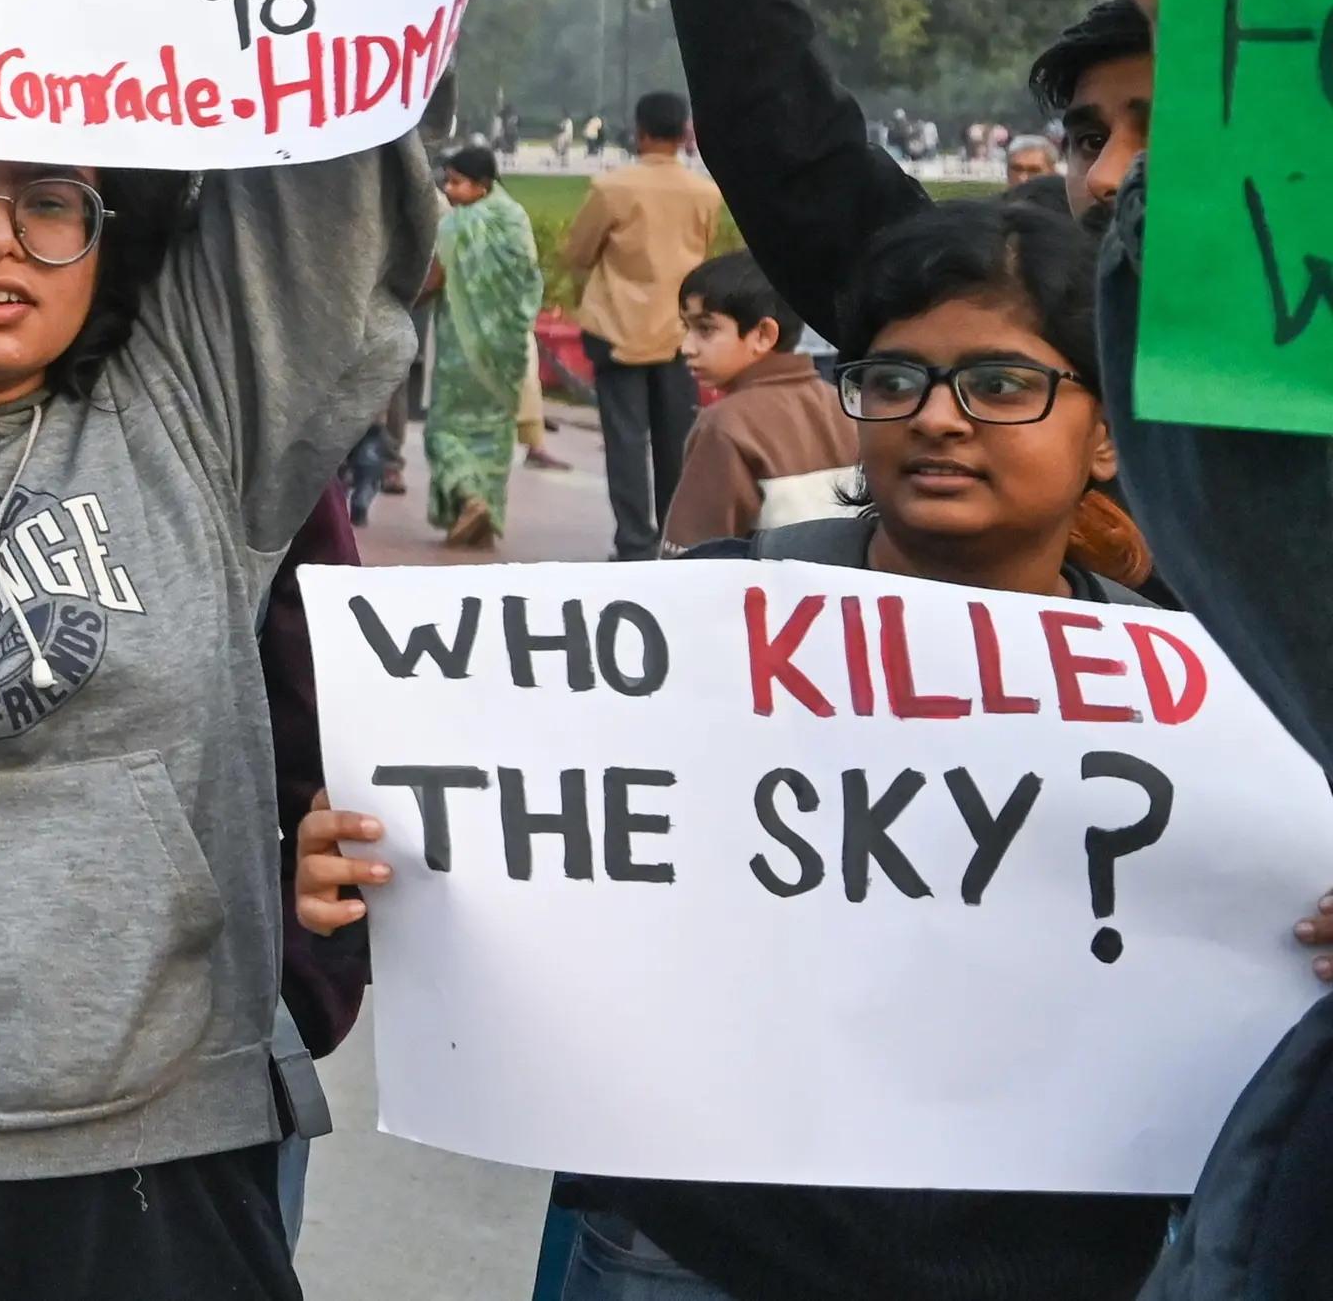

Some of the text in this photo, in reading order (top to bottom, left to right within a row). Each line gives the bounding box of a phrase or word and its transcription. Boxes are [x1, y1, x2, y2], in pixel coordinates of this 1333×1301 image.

[348, 586, 1208, 725] WHO KILLED
[371, 764, 677, 884] THE
